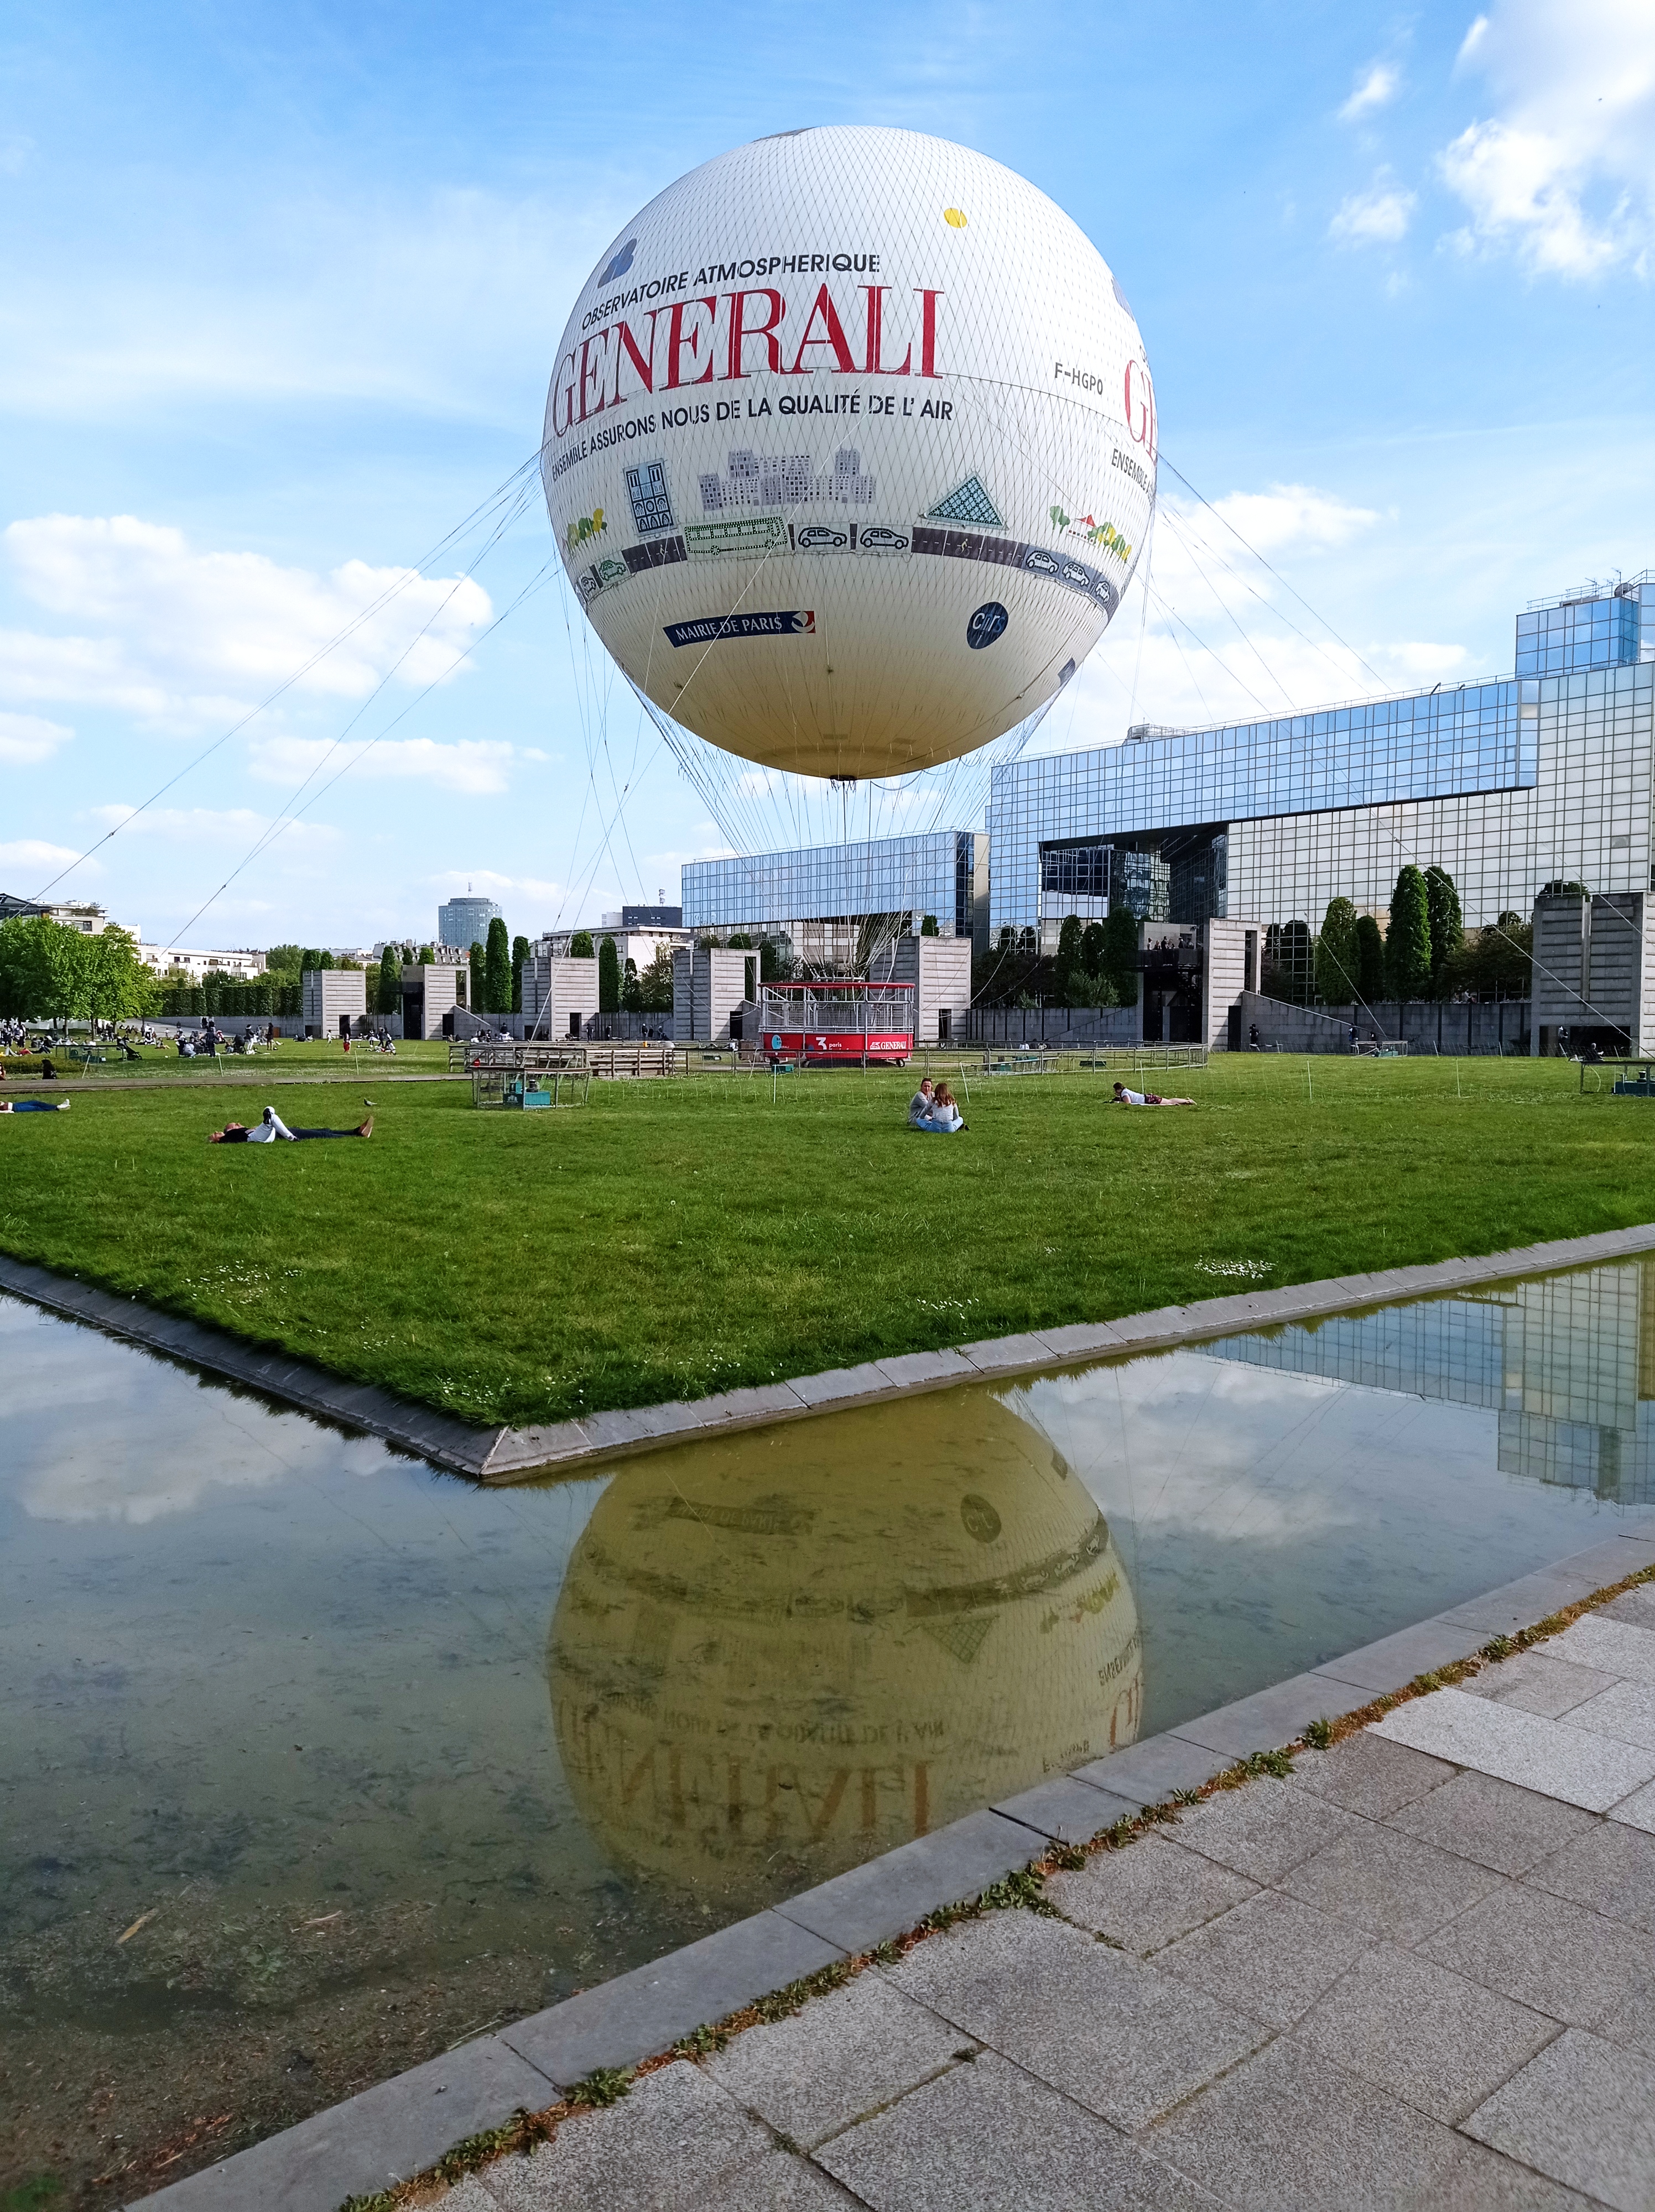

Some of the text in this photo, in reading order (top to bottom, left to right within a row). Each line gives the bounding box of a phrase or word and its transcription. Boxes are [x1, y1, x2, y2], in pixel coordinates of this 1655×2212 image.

[582, 254, 879, 330] OBSERVATOIRE ATMOSPHERIQUE
[553, 283, 945, 438] GENERALI
[553, 440, 587, 482] ENSEMBLE
[590, 414, 657, 455] ASSURONS
[661, 404, 710, 430] NOUS
[716, 400, 740, 421] DE
[748, 397, 772, 417] LA
[778, 389, 860, 414] QUALITÉ
[868, 395, 894, 415] DE
[919, 399, 953, 421] AIR
[676, 617, 783, 641] MAIRIE DE PARIS
[881, 1041, 907, 1050] GENERALI
